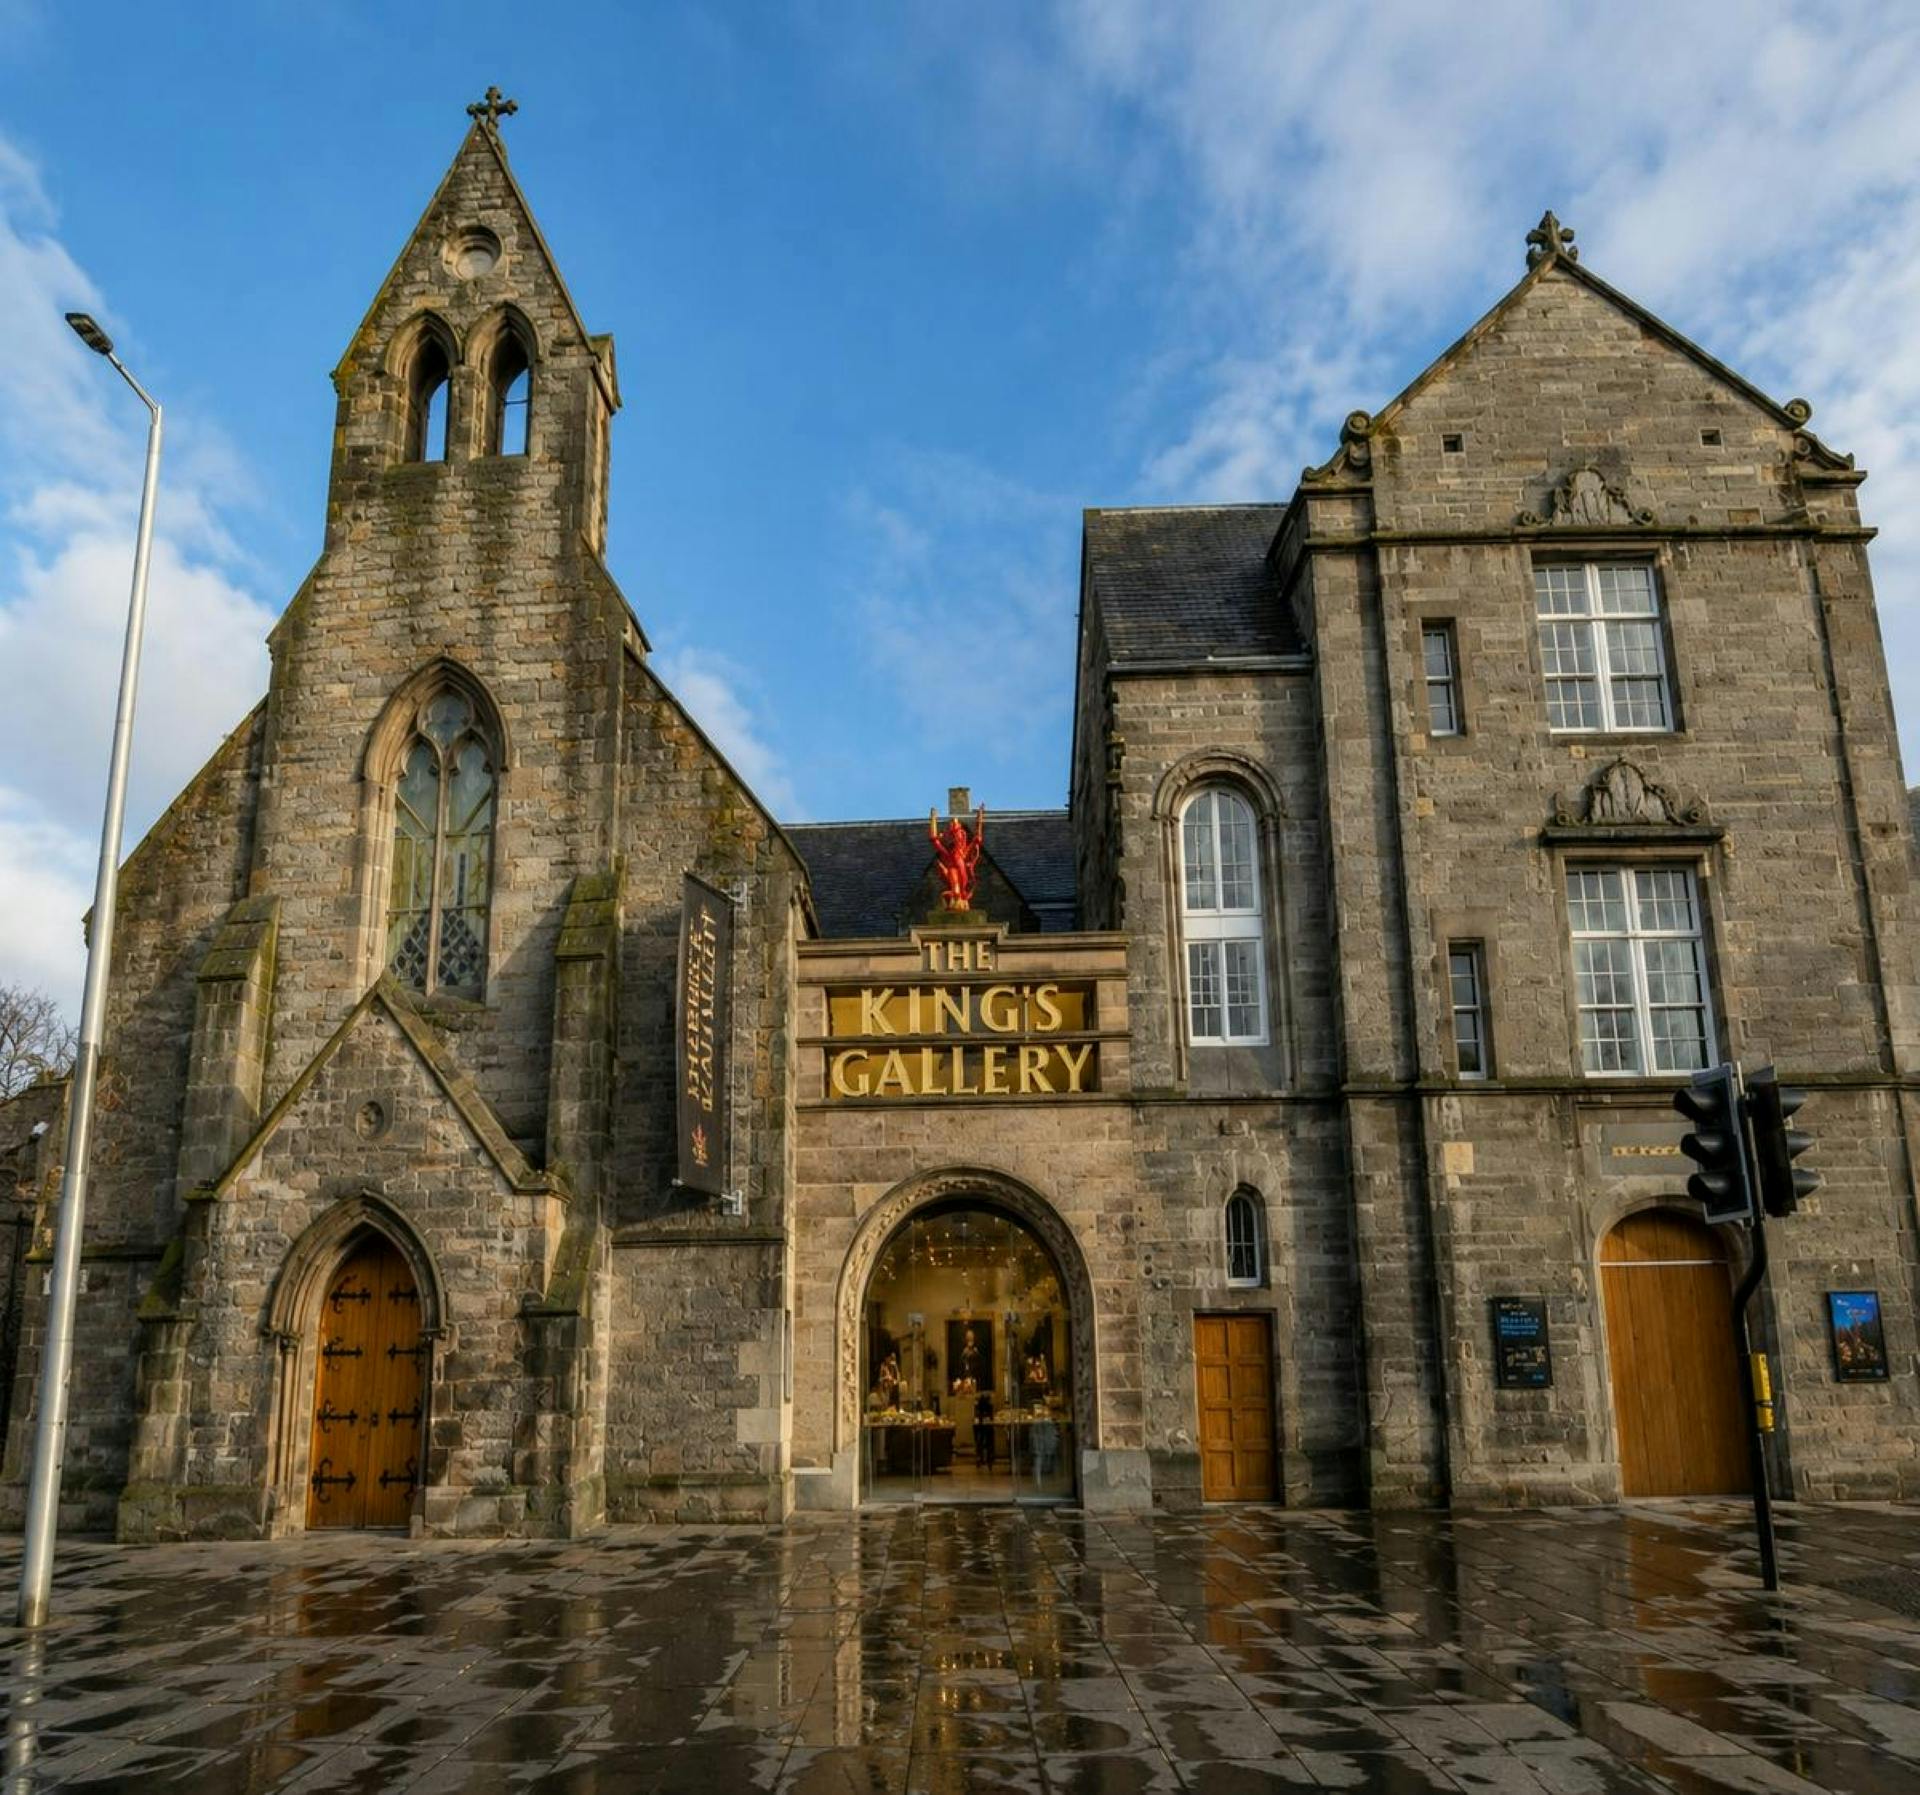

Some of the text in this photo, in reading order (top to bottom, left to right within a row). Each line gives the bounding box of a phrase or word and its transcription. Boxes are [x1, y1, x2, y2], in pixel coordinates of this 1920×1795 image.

[924, 941, 993, 971] THE
[861, 983, 1063, 1034] KING'S
[832, 1044, 1093, 1097] GALLERY
